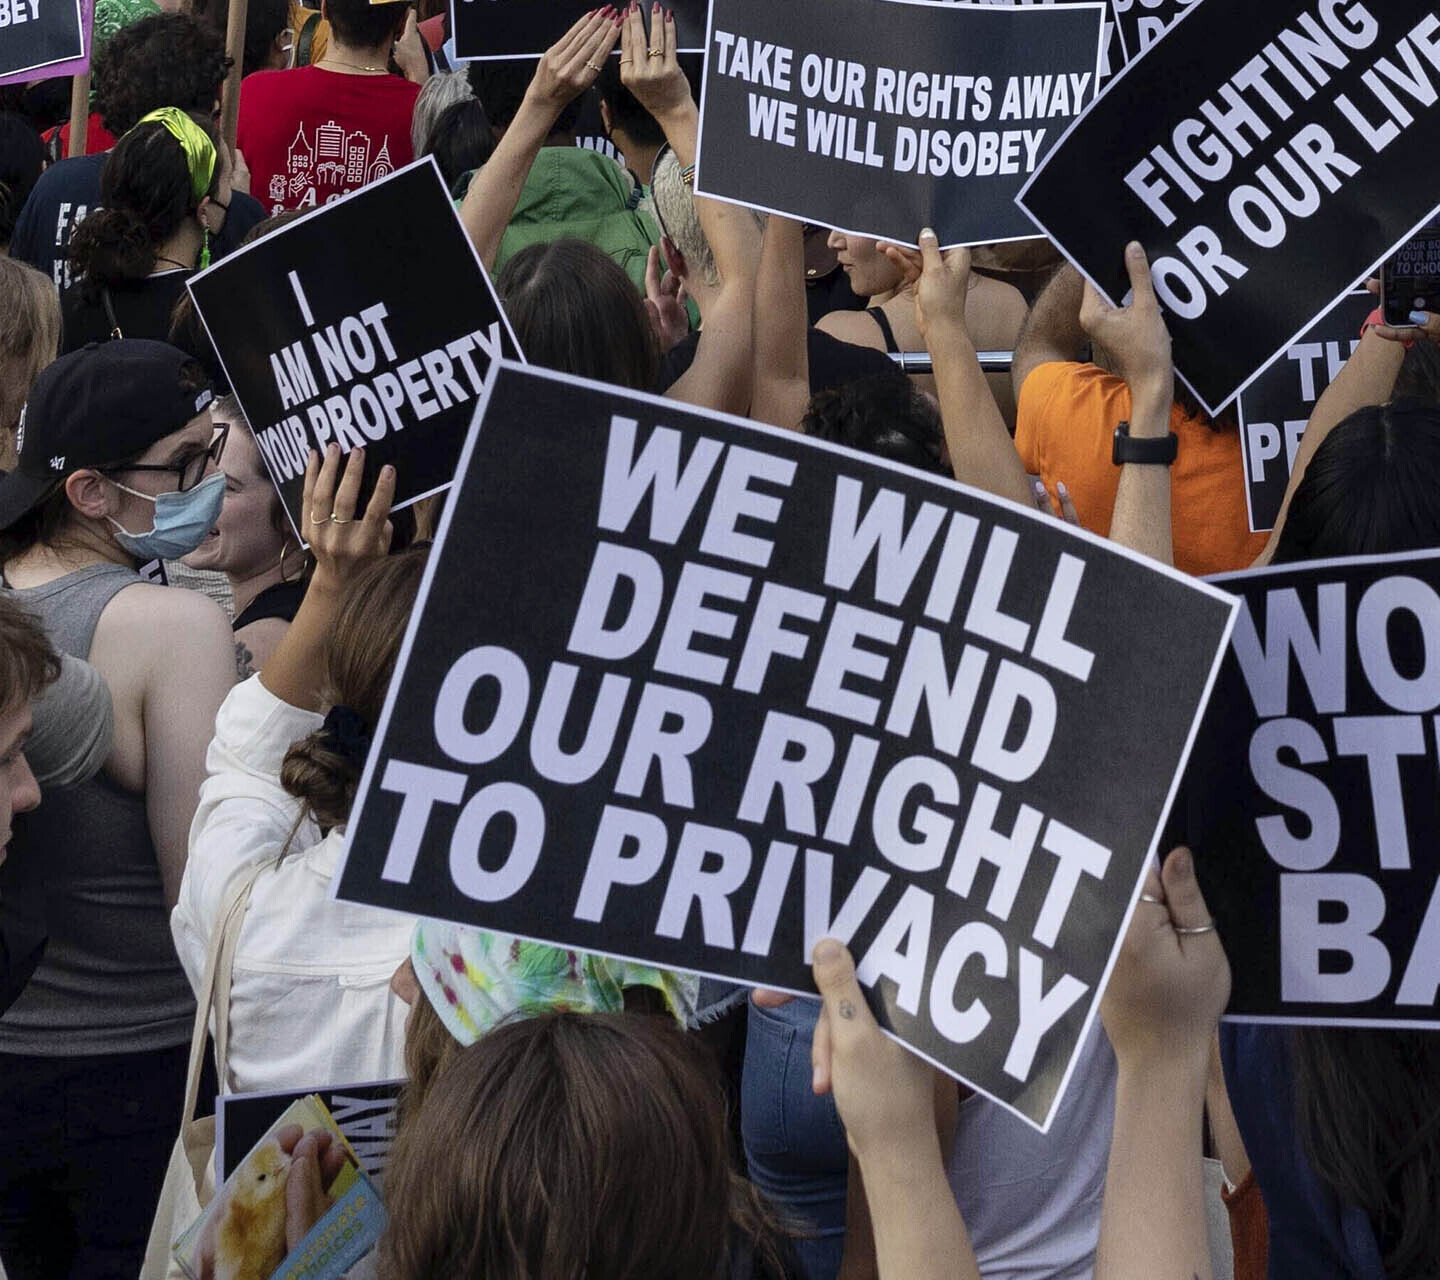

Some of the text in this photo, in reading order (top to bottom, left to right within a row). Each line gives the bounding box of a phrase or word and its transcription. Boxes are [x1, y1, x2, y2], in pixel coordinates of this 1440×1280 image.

[1149, 224, 1249, 321] OR
[1228, 121, 1361, 249] OUR
[565, 540, 1058, 784] DEFEND
[596, 415, 1096, 682] WE WILL
[380, 758, 1088, 1084] TO PRIVACY
[433, 645, 1113, 950] OUR RIGHT
